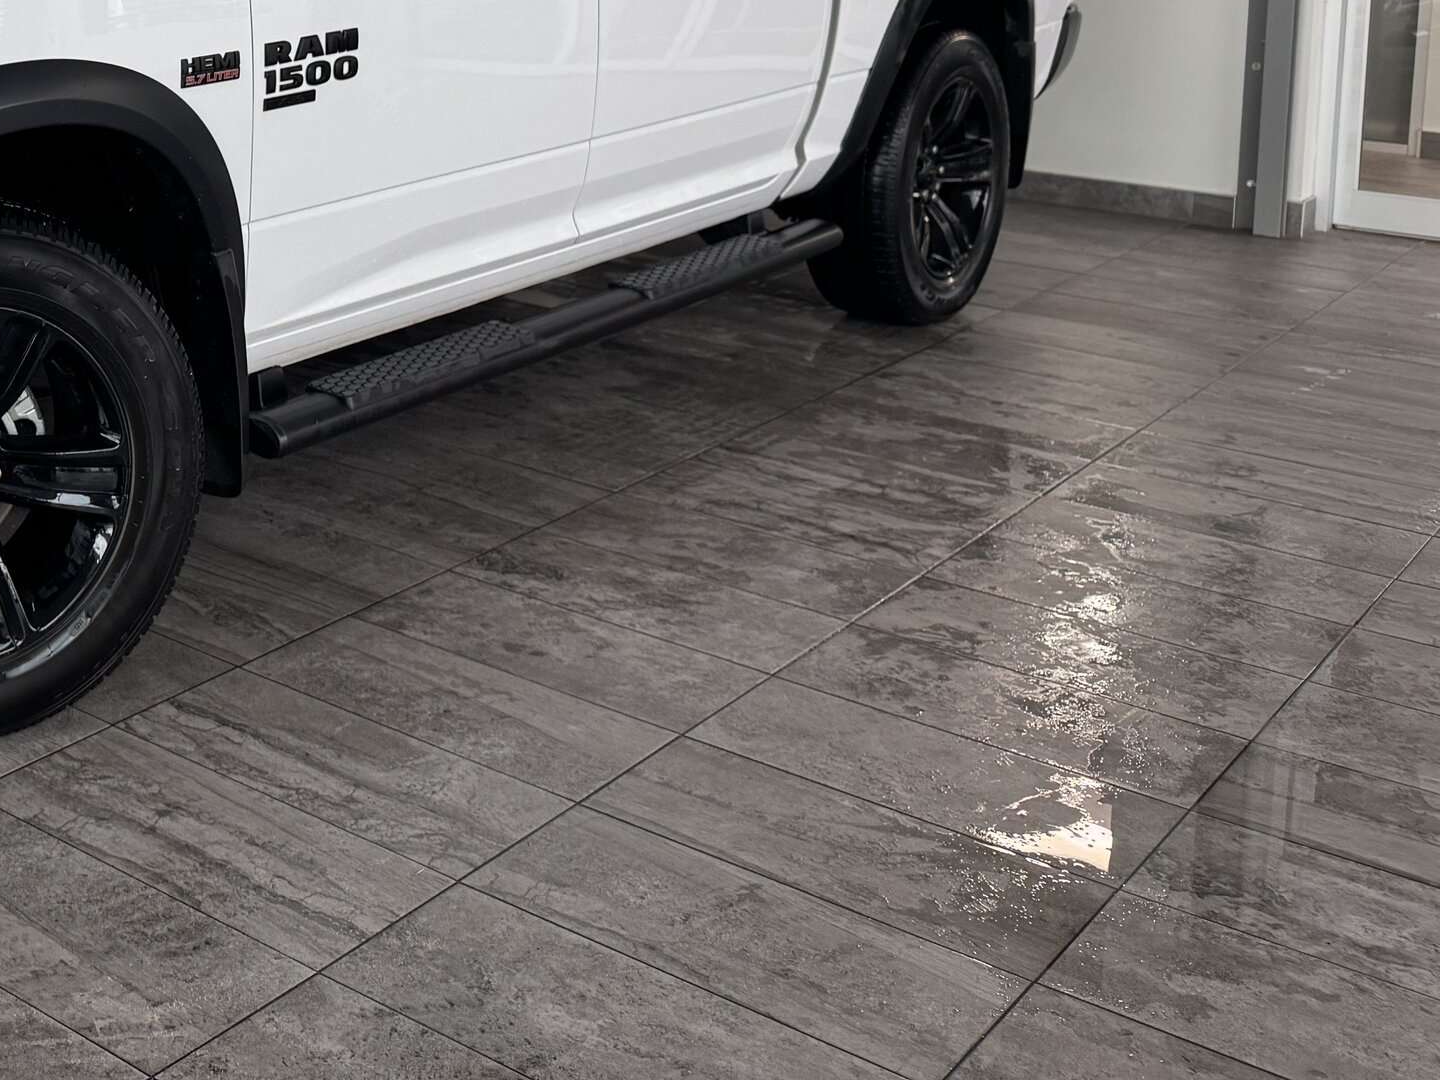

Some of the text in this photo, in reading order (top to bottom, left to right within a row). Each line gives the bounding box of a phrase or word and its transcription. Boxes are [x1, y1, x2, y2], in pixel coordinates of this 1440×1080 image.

[180, 50, 241, 76] HEMI
[264, 27, 359, 67] RAM
[264, 55, 359, 95] 1500
